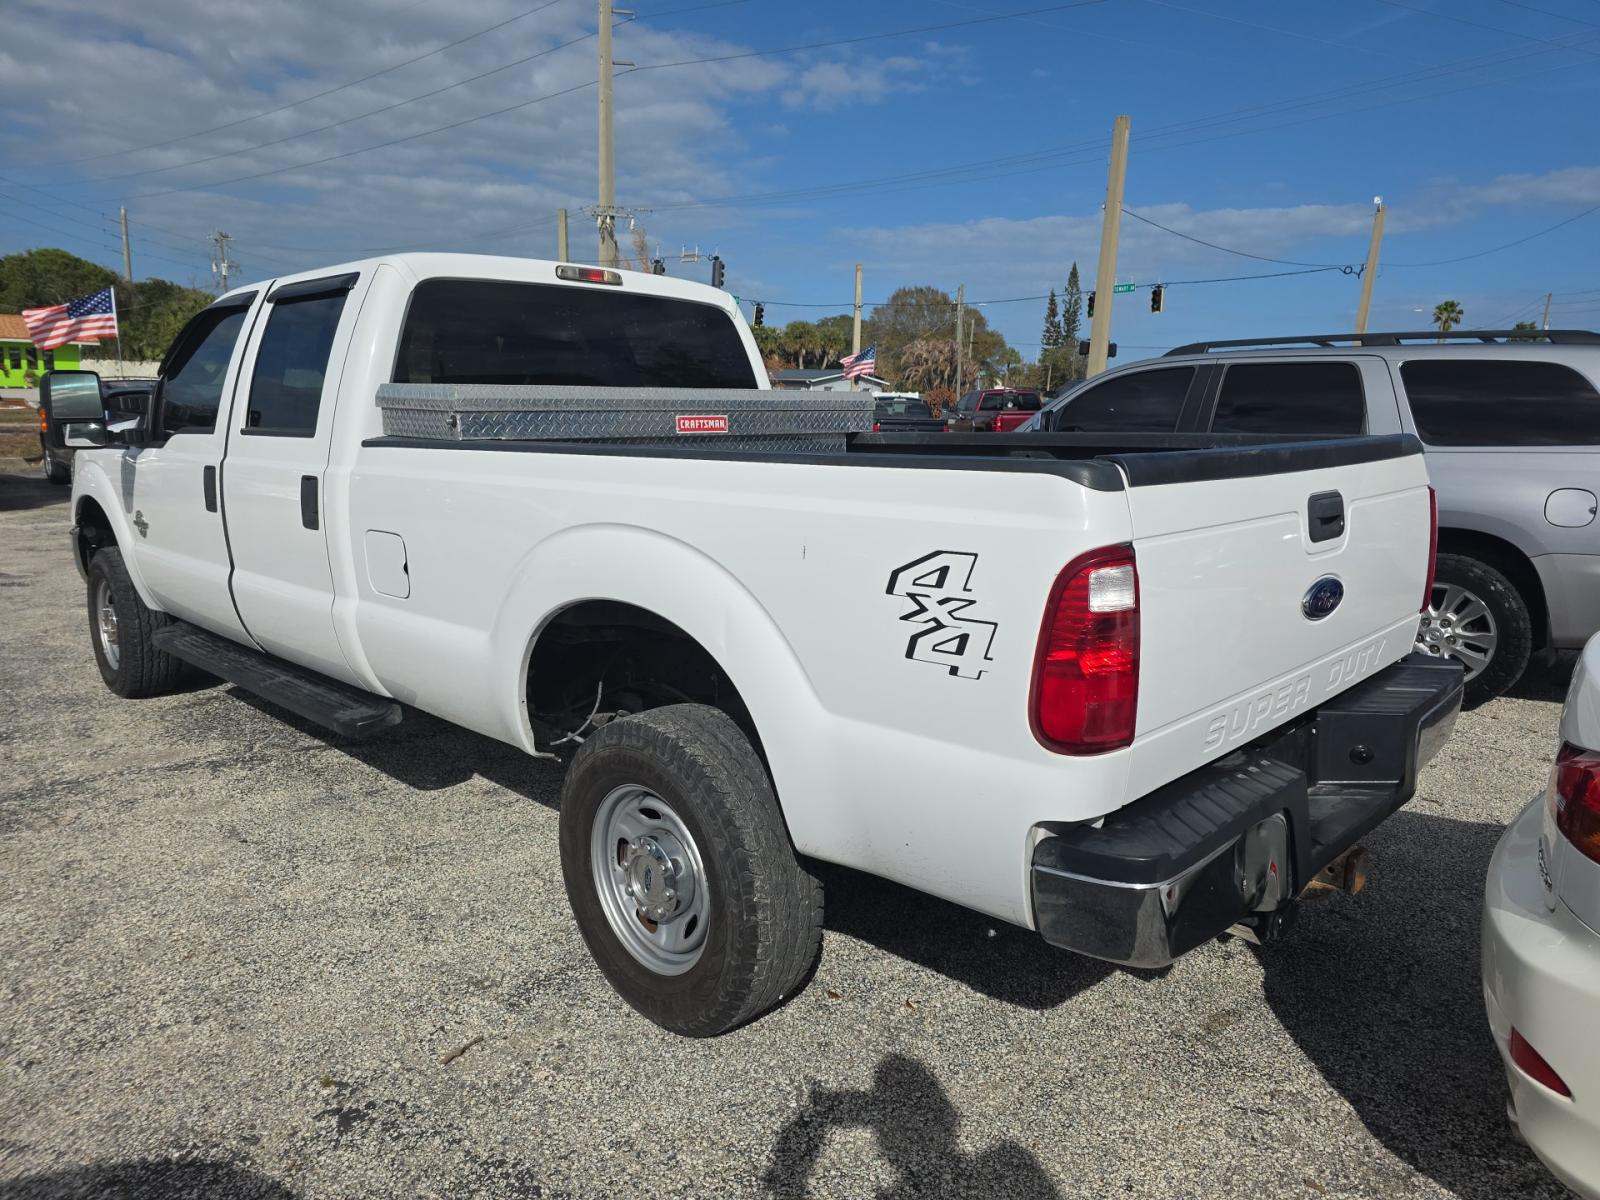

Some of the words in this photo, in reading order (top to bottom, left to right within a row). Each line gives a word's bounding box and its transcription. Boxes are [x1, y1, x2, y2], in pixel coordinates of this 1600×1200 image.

[679, 419, 726, 429] CRAFTSMAN
[1202, 674, 1312, 753] SUPER
[1325, 639, 1387, 691] DUTY
